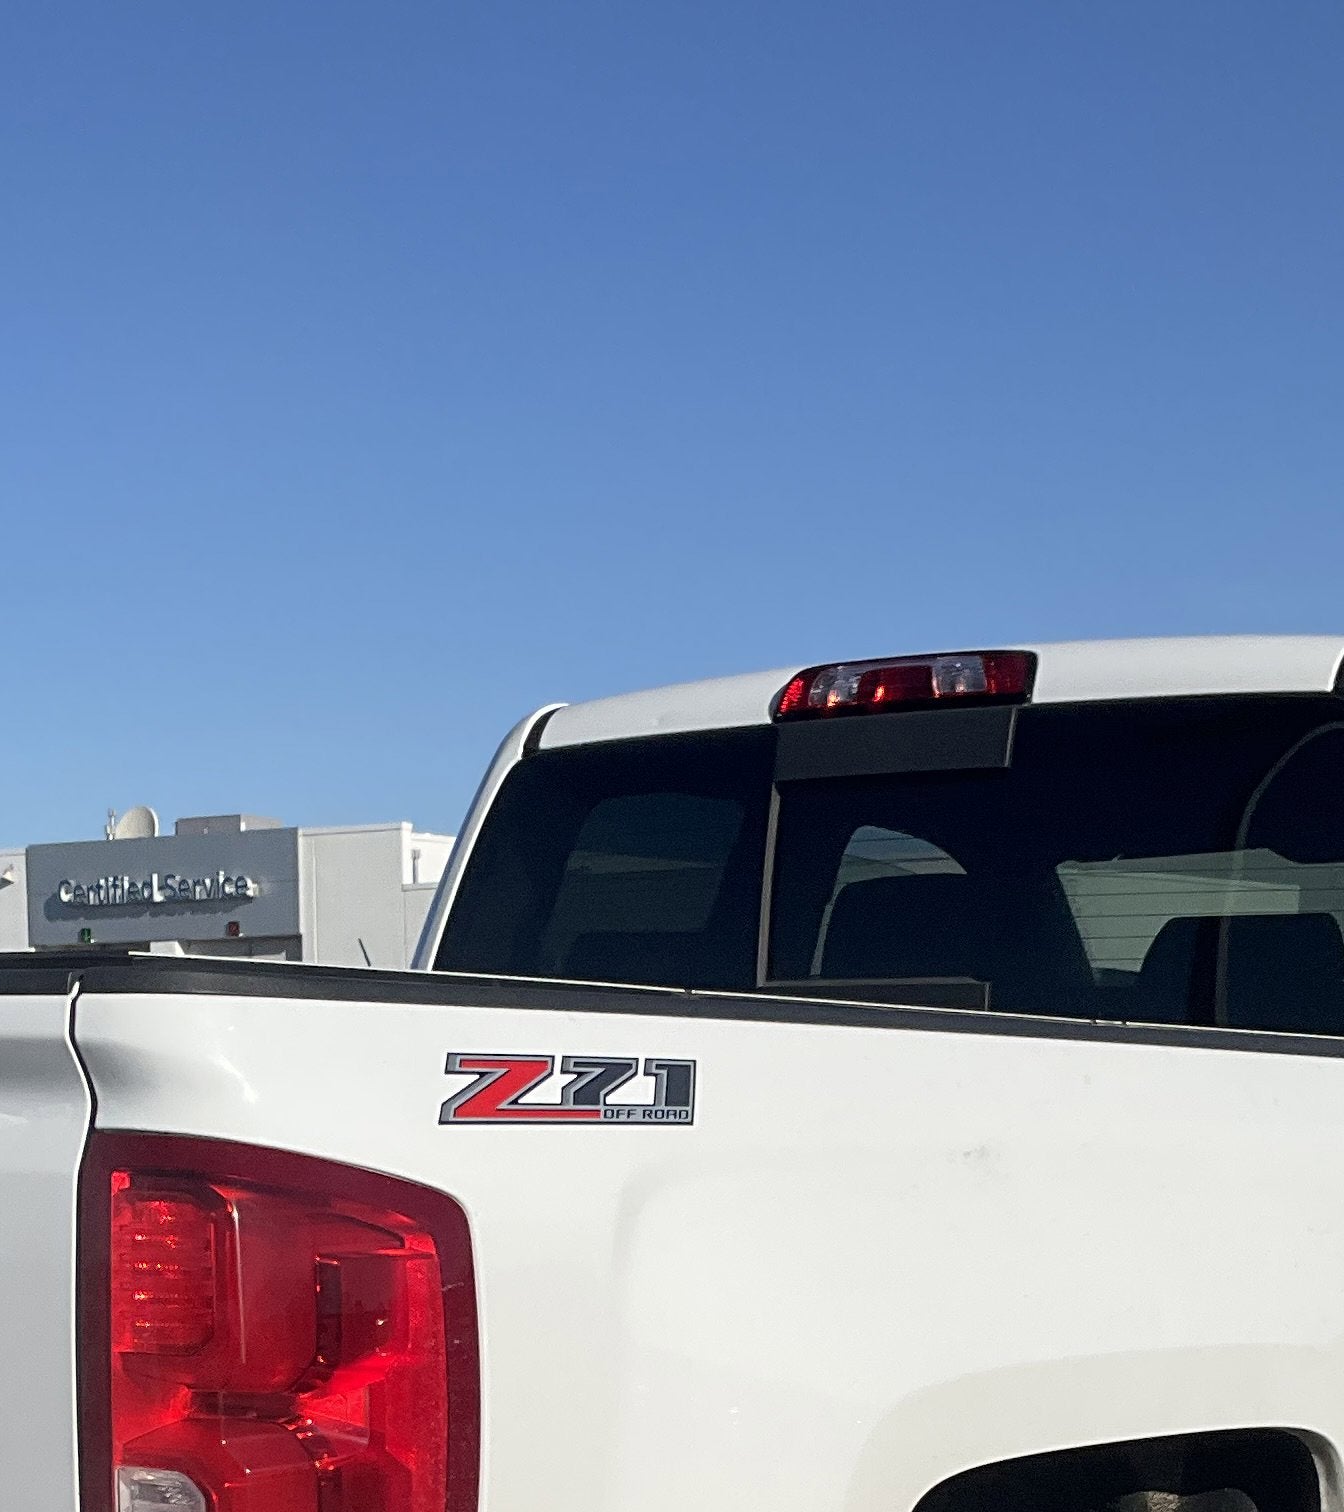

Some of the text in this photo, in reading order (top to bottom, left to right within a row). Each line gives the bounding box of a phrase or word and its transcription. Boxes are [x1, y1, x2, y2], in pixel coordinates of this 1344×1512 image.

[57, 871, 258, 904] Certified Service
[438, 1052, 697, 1125] Z71
[603, 1108, 690, 1119] OFF ROAD
